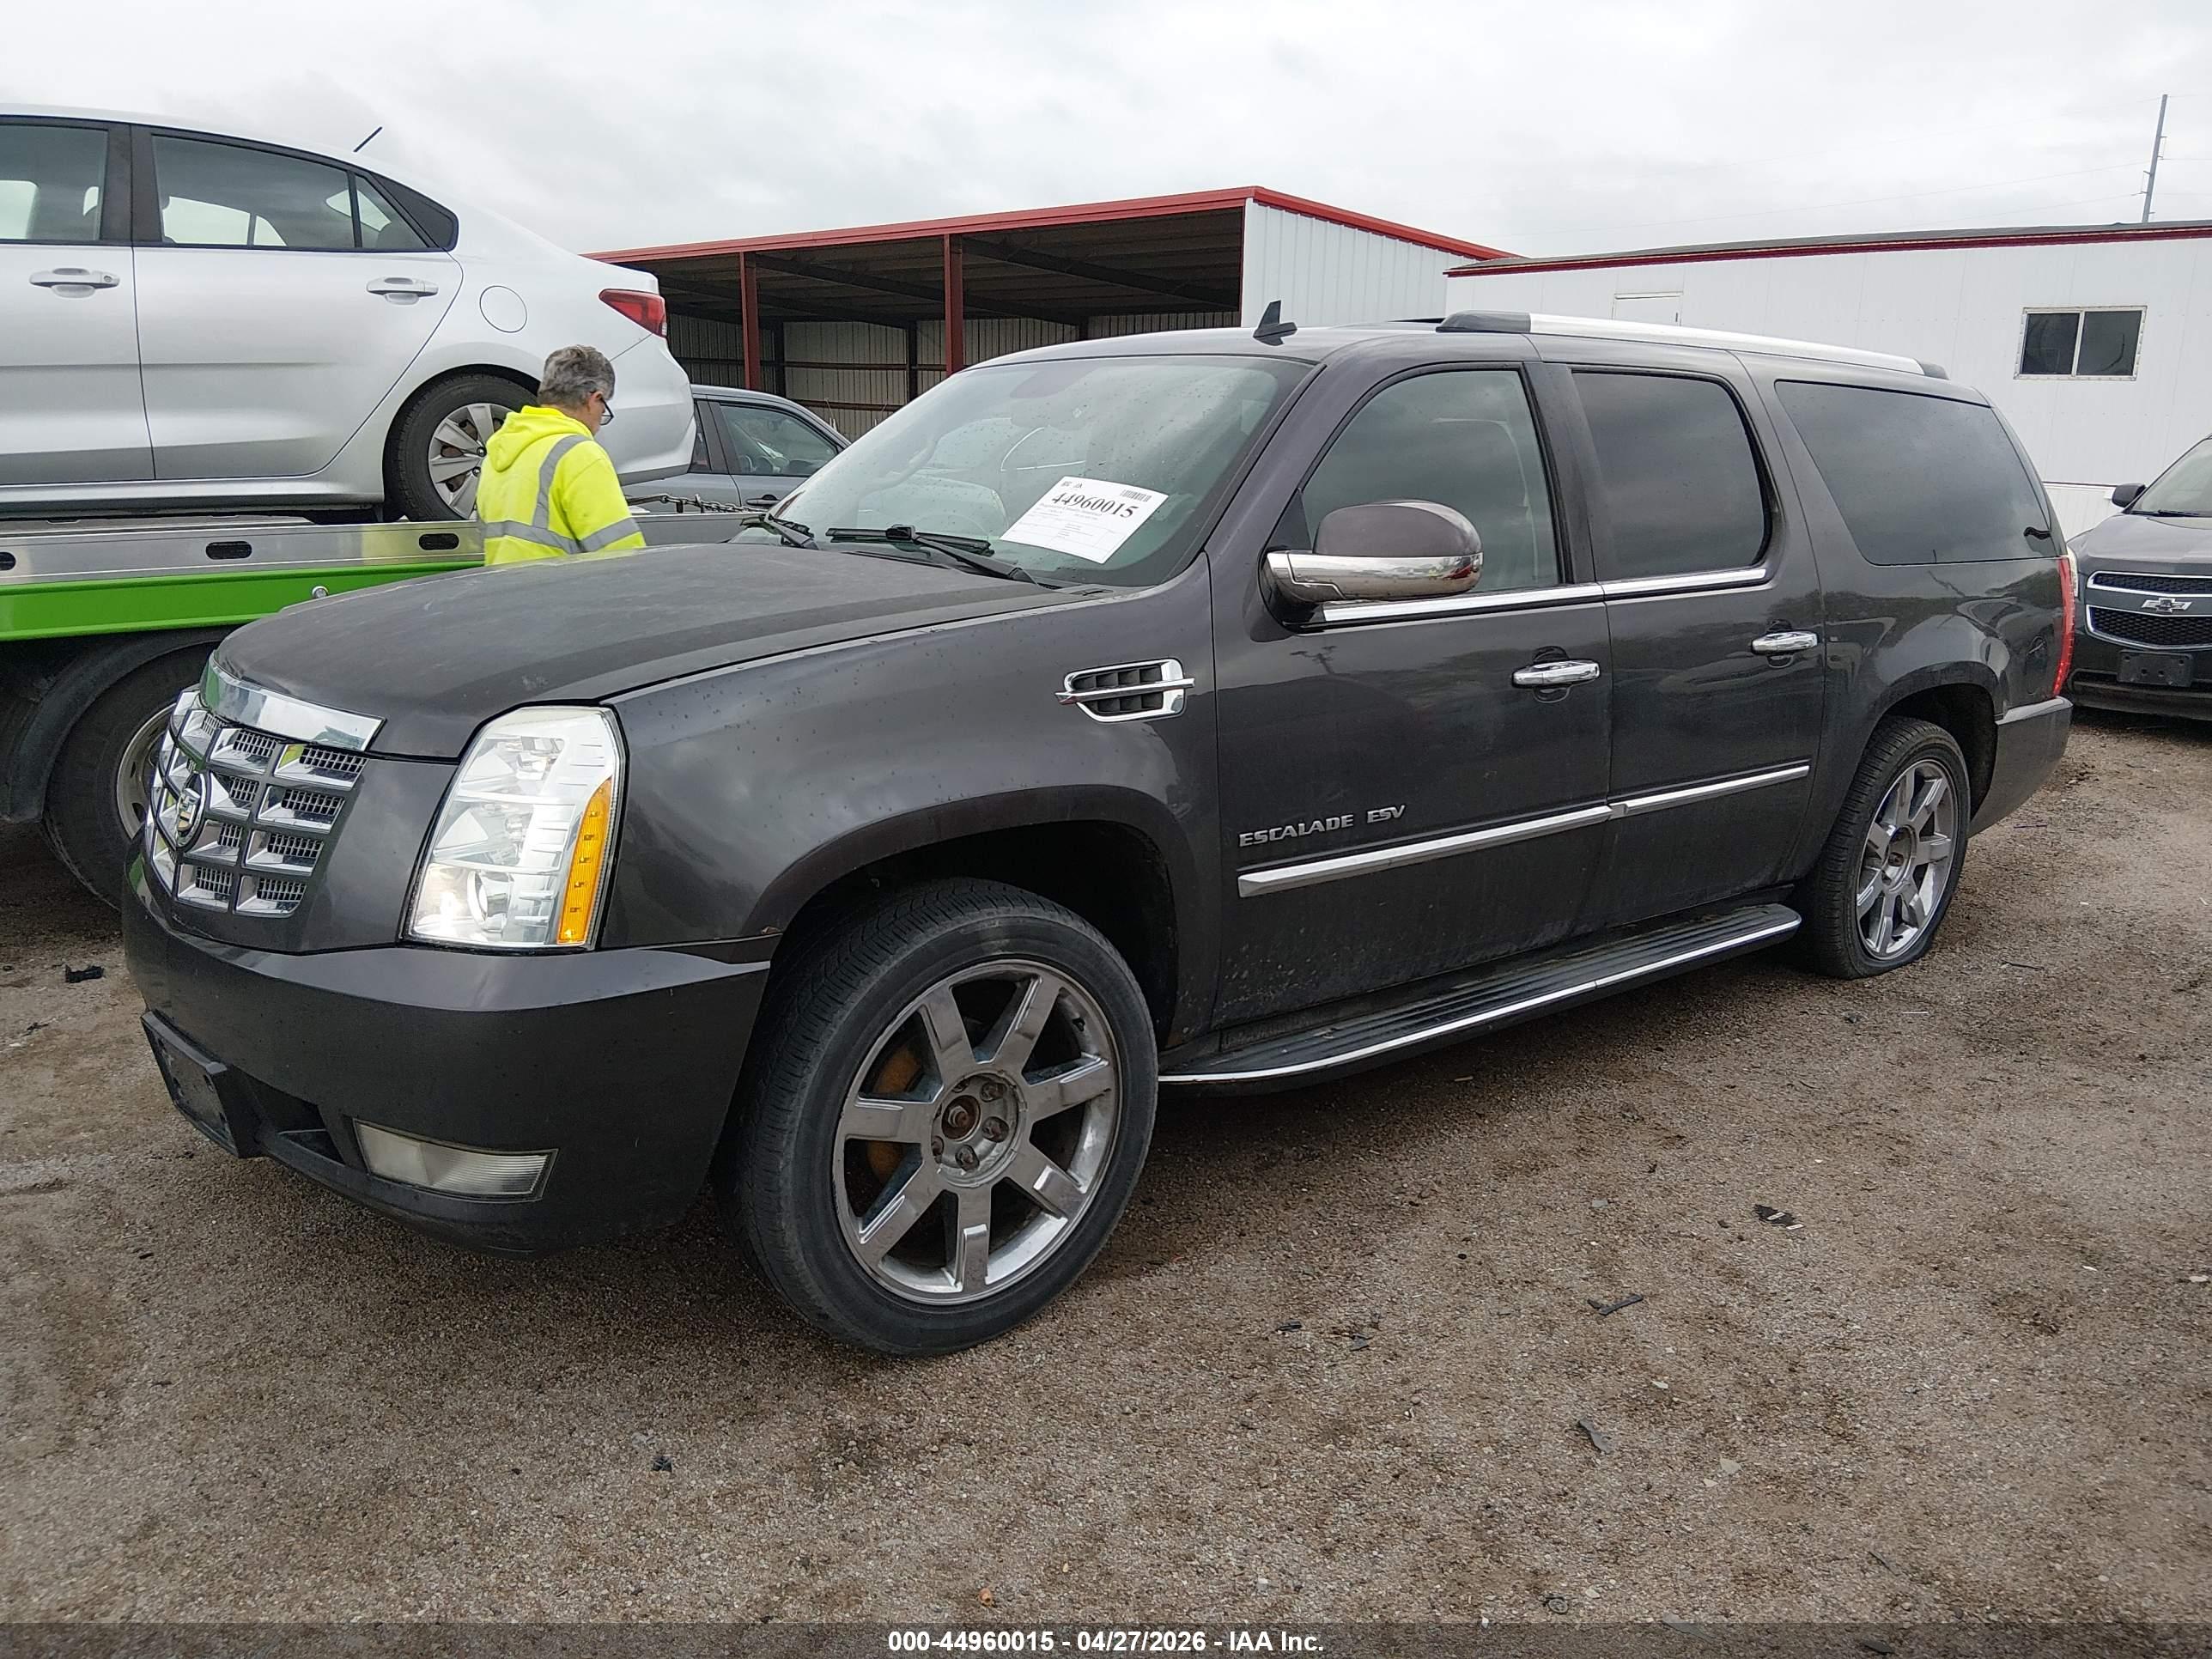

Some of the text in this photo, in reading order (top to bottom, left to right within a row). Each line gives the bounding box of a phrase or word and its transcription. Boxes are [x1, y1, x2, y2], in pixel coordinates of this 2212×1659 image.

[1052, 492, 1139, 519] 44960015
[1238, 805, 1407, 848] ESCALADE ESV
